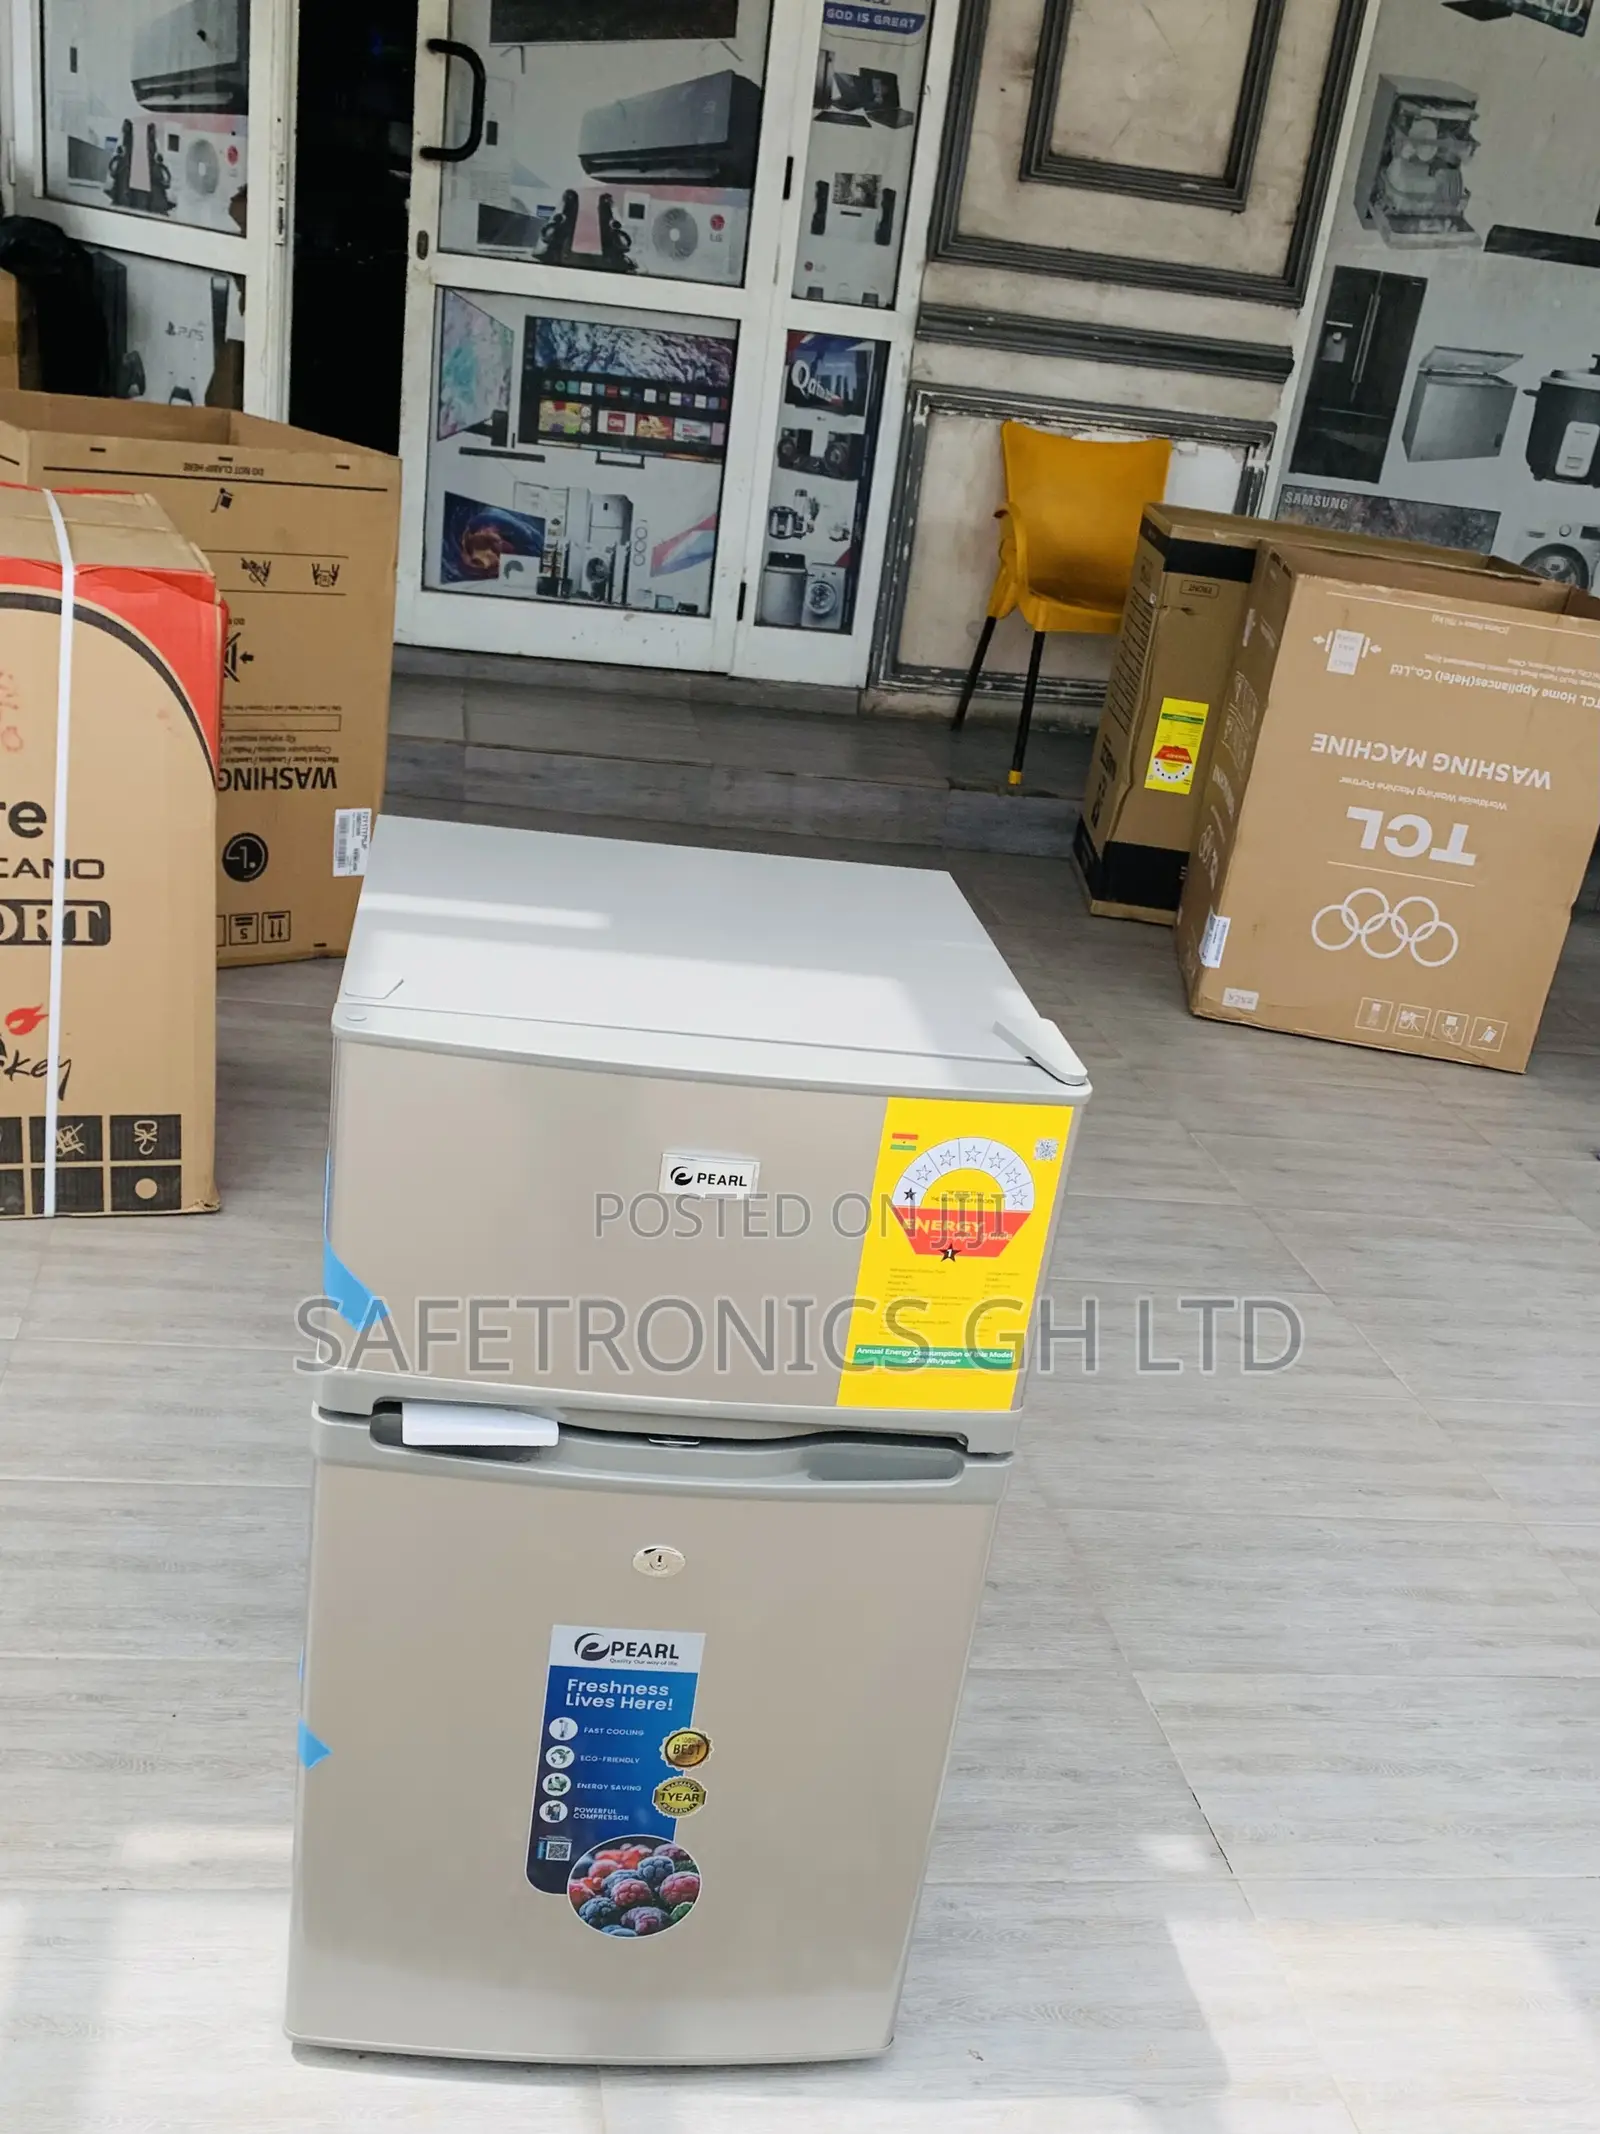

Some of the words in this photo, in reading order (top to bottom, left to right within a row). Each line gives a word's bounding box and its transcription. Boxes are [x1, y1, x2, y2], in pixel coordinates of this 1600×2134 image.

[826, 8, 853, 20] GOD
[857, 13, 870, 23] IS
[874, 15, 916, 28] GREAT
[1285, 491, 1349, 510] SAMSUNG
[1541, 687, 1577, 704] Home
[1311, 733, 1427, 769] MACHINE
[218, 766, 338, 792] WASHING
[1432, 753, 1552, 790] WASHING
[1339, 777, 1375, 790] Partner
[1377, 782, 1416, 796] Machine
[1417, 787, 1457, 803] Washing
[1458, 795, 1508, 811] Worldwide
[0, 800, 47, 839] e
[1346, 806, 1477, 866] TCL
[0, 1049, 72, 1101] key
[696, 1172, 748, 1187] PEARL
[902, 1217, 985, 1235] ENERGY
[856, 1347, 885, 1355] Annual
[885, 1348, 912, 1357] Energy
[610, 1641, 680, 1660] PEARL
[567, 1678, 669, 1696] Freshness
[565, 1693, 615, 1708] Lives
[620, 1696, 673, 1711] Here!
[583, 1727, 604, 1735] FAST
[606, 1728, 645, 1736] COOLING
[673, 1742, 702, 1756] BEST
[580, 1754, 641, 1764] ECO-FRIENDLY
[576, 1782, 609, 1791] ENERGY
[610, 1783, 642, 1792] SAVING
[573, 1813, 630, 1821] COMPRESSOR
[574, 1806, 617, 1815] POWERFUL
